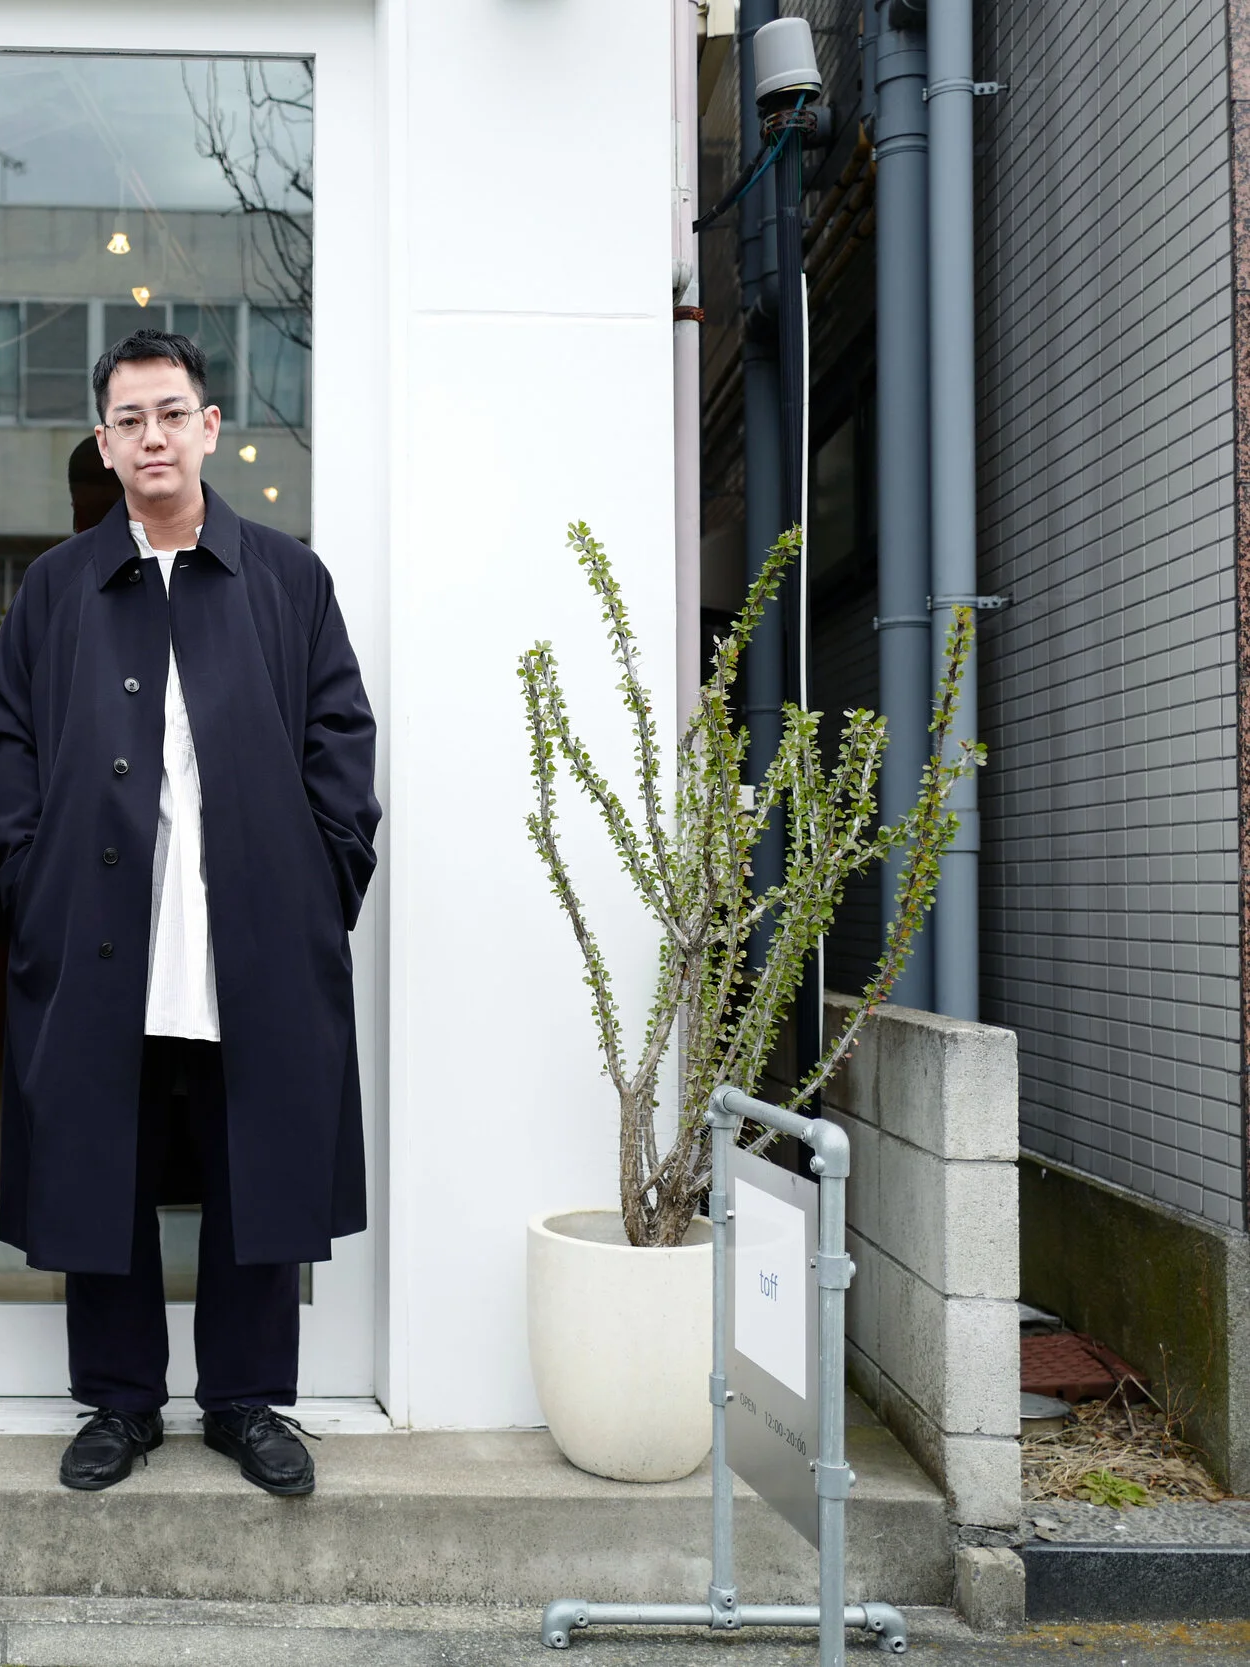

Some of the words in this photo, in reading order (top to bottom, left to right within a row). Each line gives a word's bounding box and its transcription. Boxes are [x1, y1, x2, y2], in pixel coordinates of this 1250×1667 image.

[759, 1269, 778, 1302] toff
[739, 1392, 757, 1416] OPEN
[764, 1411, 807, 1456] 12:00-20:00
